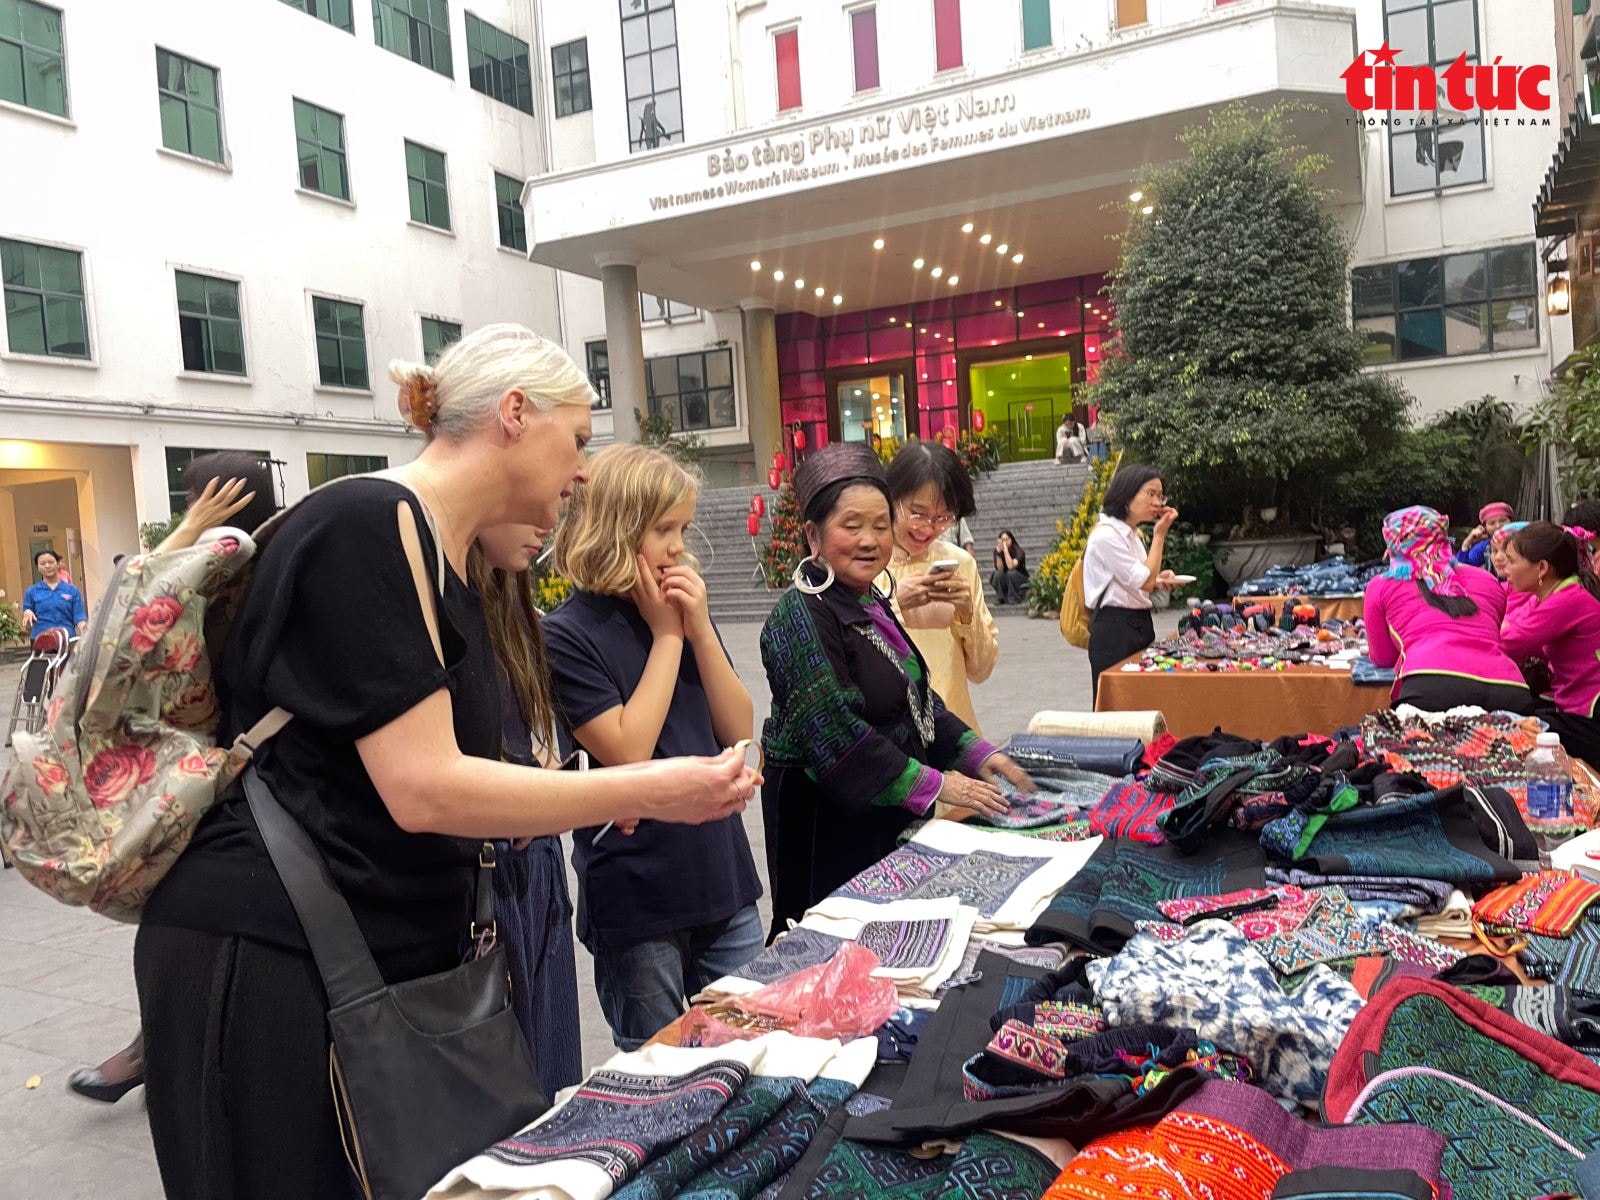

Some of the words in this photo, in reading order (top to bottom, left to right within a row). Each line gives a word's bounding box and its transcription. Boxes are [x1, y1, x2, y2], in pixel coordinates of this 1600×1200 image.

[649, 187, 724, 211] Vietnamese
[724, 172, 782, 195] Women's
[782, 162, 841, 184] Museum
[853, 147, 899, 169] Musée
[900, 141, 928, 159] des
[930, 128, 994, 153] Femmes
[998, 121, 1017, 139] du
[1020, 107, 1091, 134] Vietnam
[707, 147, 749, 178] Bảo
[752, 138, 805, 166] tàng
[809, 128, 854, 155] Phụ
[859, 114, 892, 144] nữ
[897, 100, 949, 134] Việt
[955, 92, 1016, 122] Nam
